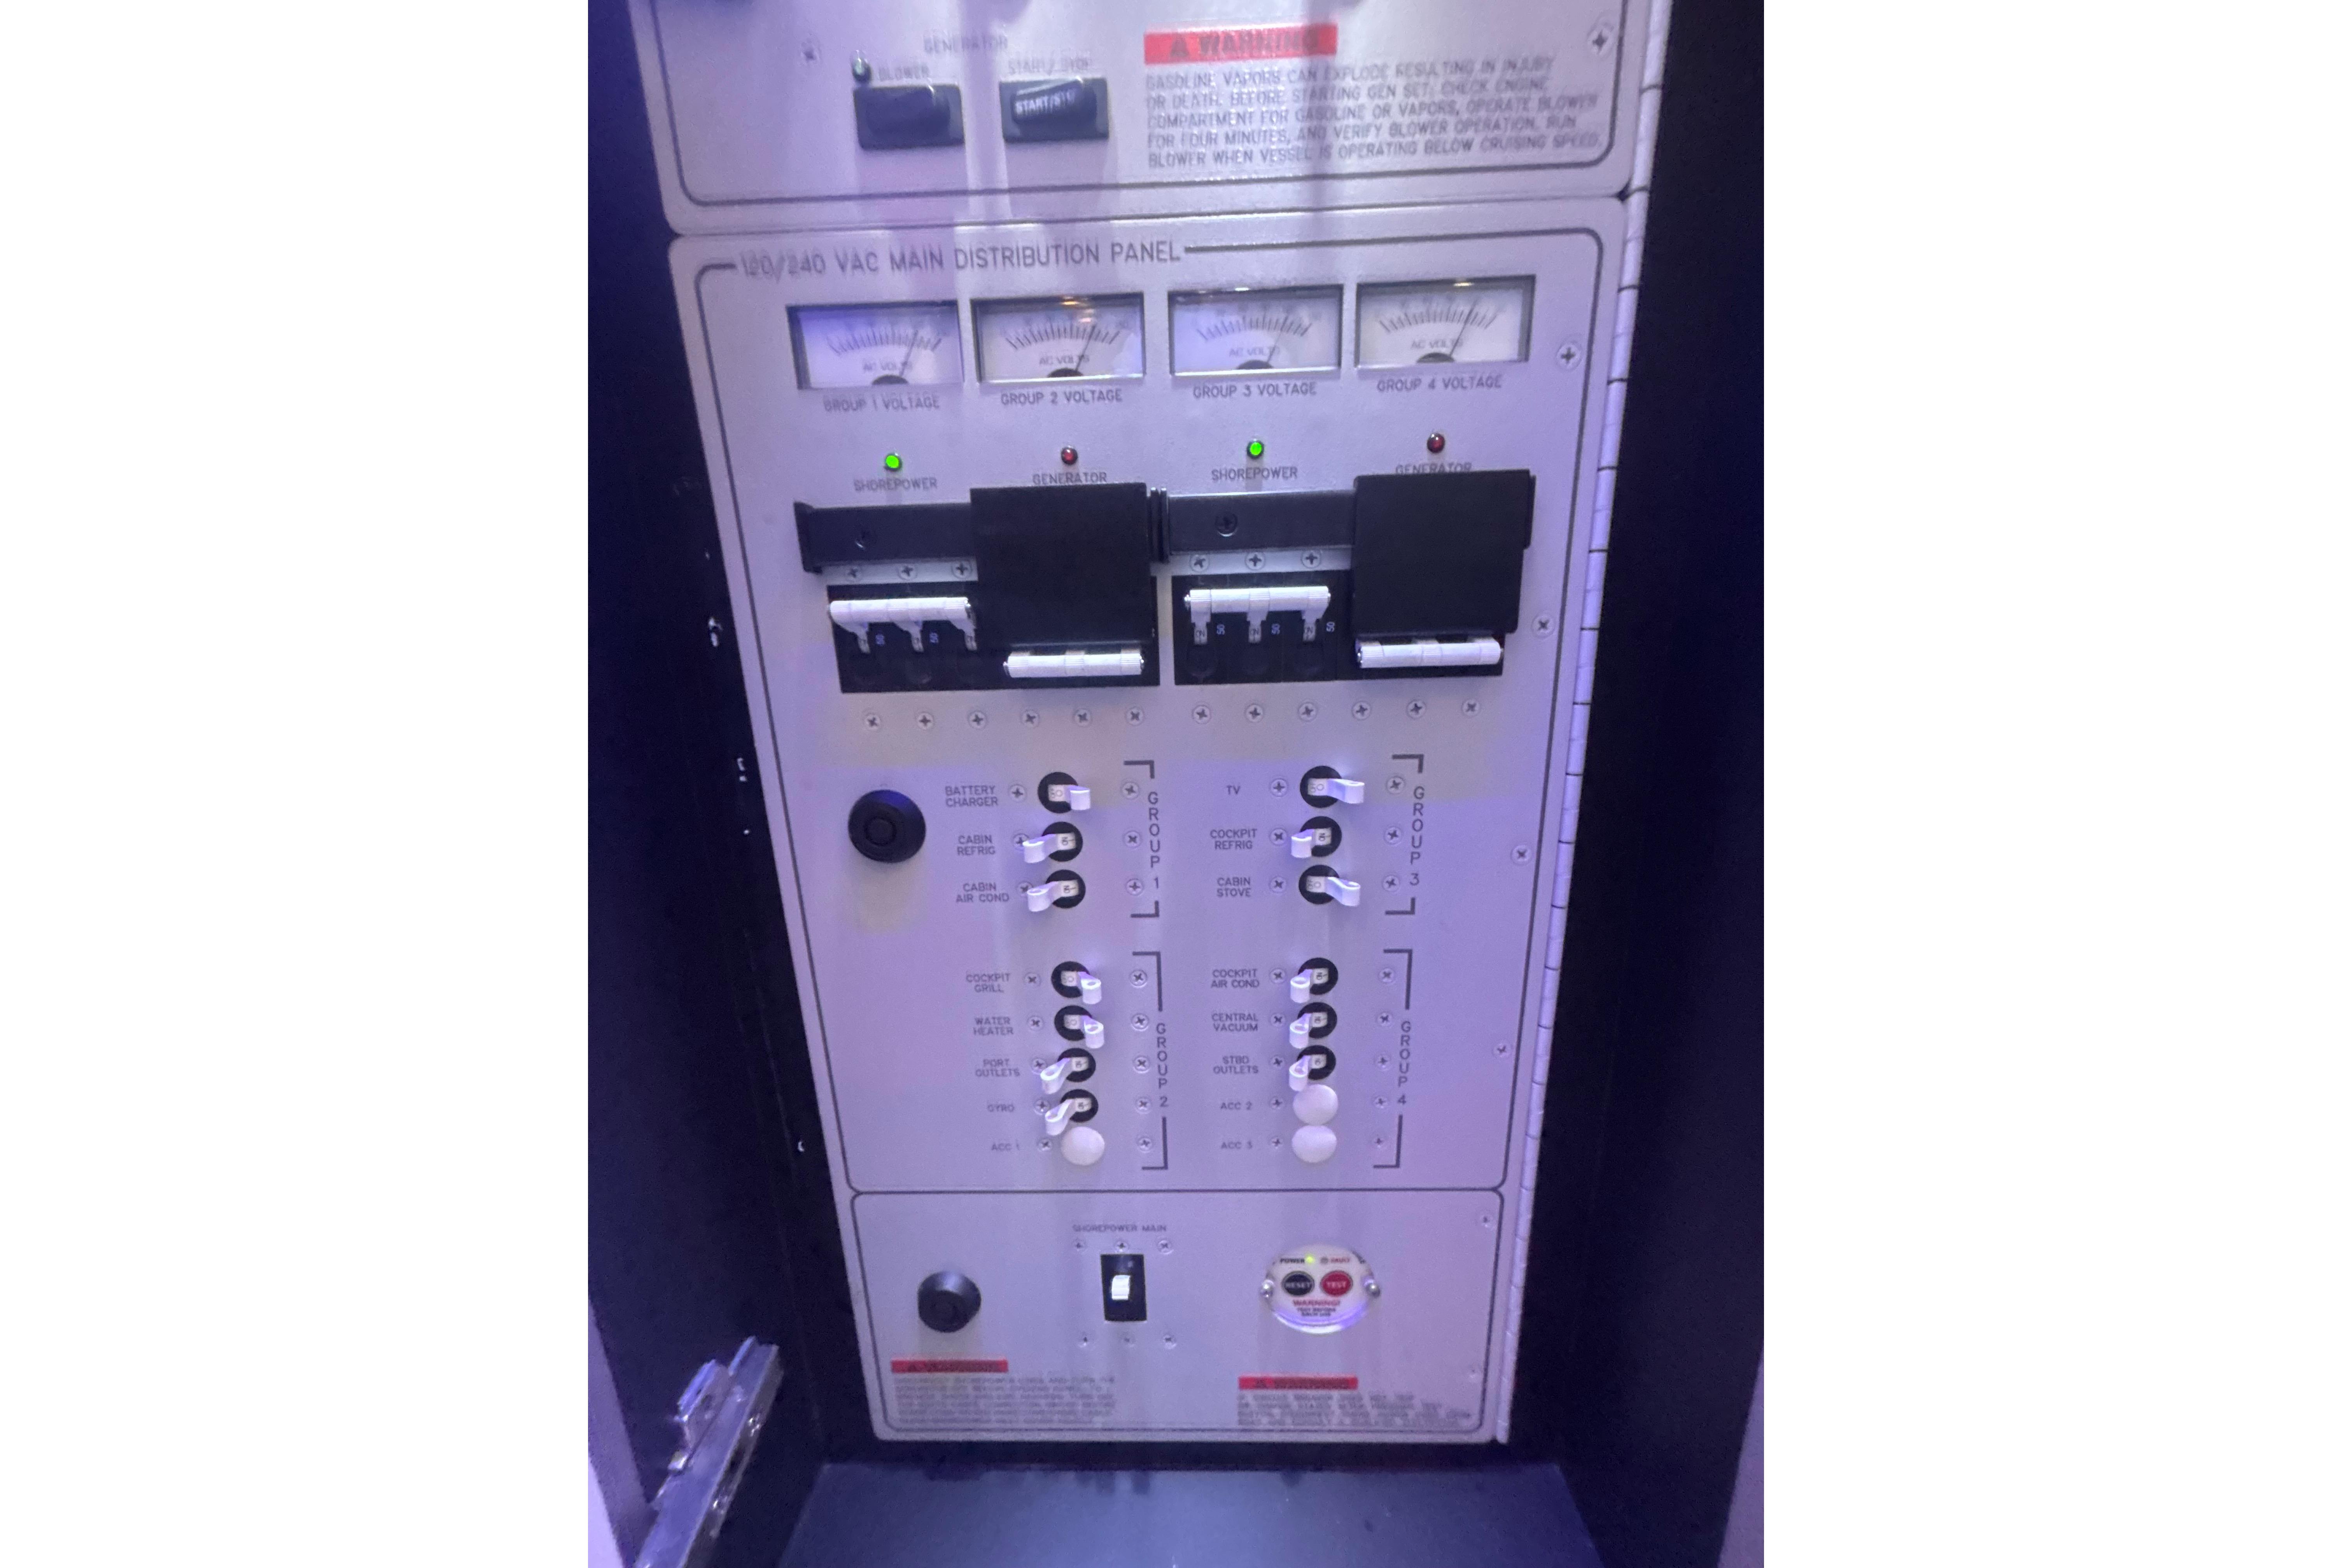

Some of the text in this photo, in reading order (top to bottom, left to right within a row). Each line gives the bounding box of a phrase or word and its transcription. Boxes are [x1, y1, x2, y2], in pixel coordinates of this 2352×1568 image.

[1286, 66, 1318, 83] CAN
[1146, 94, 1166, 110] OR
[1260, 108, 1288, 126] FOR
[1372, 102, 1392, 119] OR
[1297, 124, 1326, 141] AND
[1333, 122, 1382, 140] VERIFY
[1389, 119, 1448, 138] BLOWER
[1148, 150, 1205, 169] BLOWER
[1212, 148, 1253, 165] WHEN
[1259, 146, 1312, 163] VESSEL
[1338, 140, 1418, 158] OPERATING
[1424, 137, 1474, 155] BELOW
[835, 250, 879, 273] VAC
[889, 247, 944, 271] MAIN
[954, 243, 1100, 271] DISTRIBUTION
[1111, 240, 1181, 263] PANEL
[1377, 373, 1503, 392] GROUP 4 VOLTAGE
[1193, 385, 1237, 400] GROUP
[1257, 382, 1317, 397] VOLTAGE
[824, 395, 866, 412] GROUP
[882, 393, 940, 410] VOLTAGE
[1001, 388, 1122, 406] GROUP 2 VOLTAGE
[1032, 472, 1107, 485] GENERATOR
[1211, 467, 1298, 482] SHOREPOWER
[854, 477, 938, 492] SHOREPOWER
[945, 785, 996, 796] BATTERY
[1227, 784, 1241, 794] TV
[945, 796, 998, 808] CHARGER
[958, 834, 992, 844] CABIN
[1210, 829, 1257, 839] COCKPIT
[1410, 786, 1425, 886] GROUP 3
[1147, 791, 1160, 889] GROUP 1
[1215, 840, 1253, 850] REFRIG
[957, 845, 996, 856] REFRIG
[963, 882, 996, 892] CABIN
[1217, 877, 1251, 887] CABIN
[956, 892, 1009, 903] AIR COND
[1217, 887, 1251, 898] STOVE
[966, 973, 1011, 983] COCKPIT
[1213, 968, 1258, 978] COCKPIT
[975, 984, 1004, 993] GRILL
[1211, 979, 1260, 989] AIR COND
[975, 1017, 1010, 1026] WATER
[1211, 1013, 1258, 1022] CENTRAL
[973, 1026, 1013, 1036] HEATER
[1213, 1023, 1258, 1032] VACUUM
[983, 1059, 1009, 1068] PORT
[1156, 1022, 1169, 1108] GROUP 2
[1397, 1020, 1411, 1105] GROUP 4
[975, 1068, 1020, 1077] OUTLETS
[1213, 1065, 1259, 1074] OUTLETS
[1220, 1101, 1252, 1111] ACC 2
[991, 1142, 1012, 1151] ACC
[1221, 1141, 1241, 1150] ACC
[1072, 1224, 1138, 1232] SHOREPOWER
